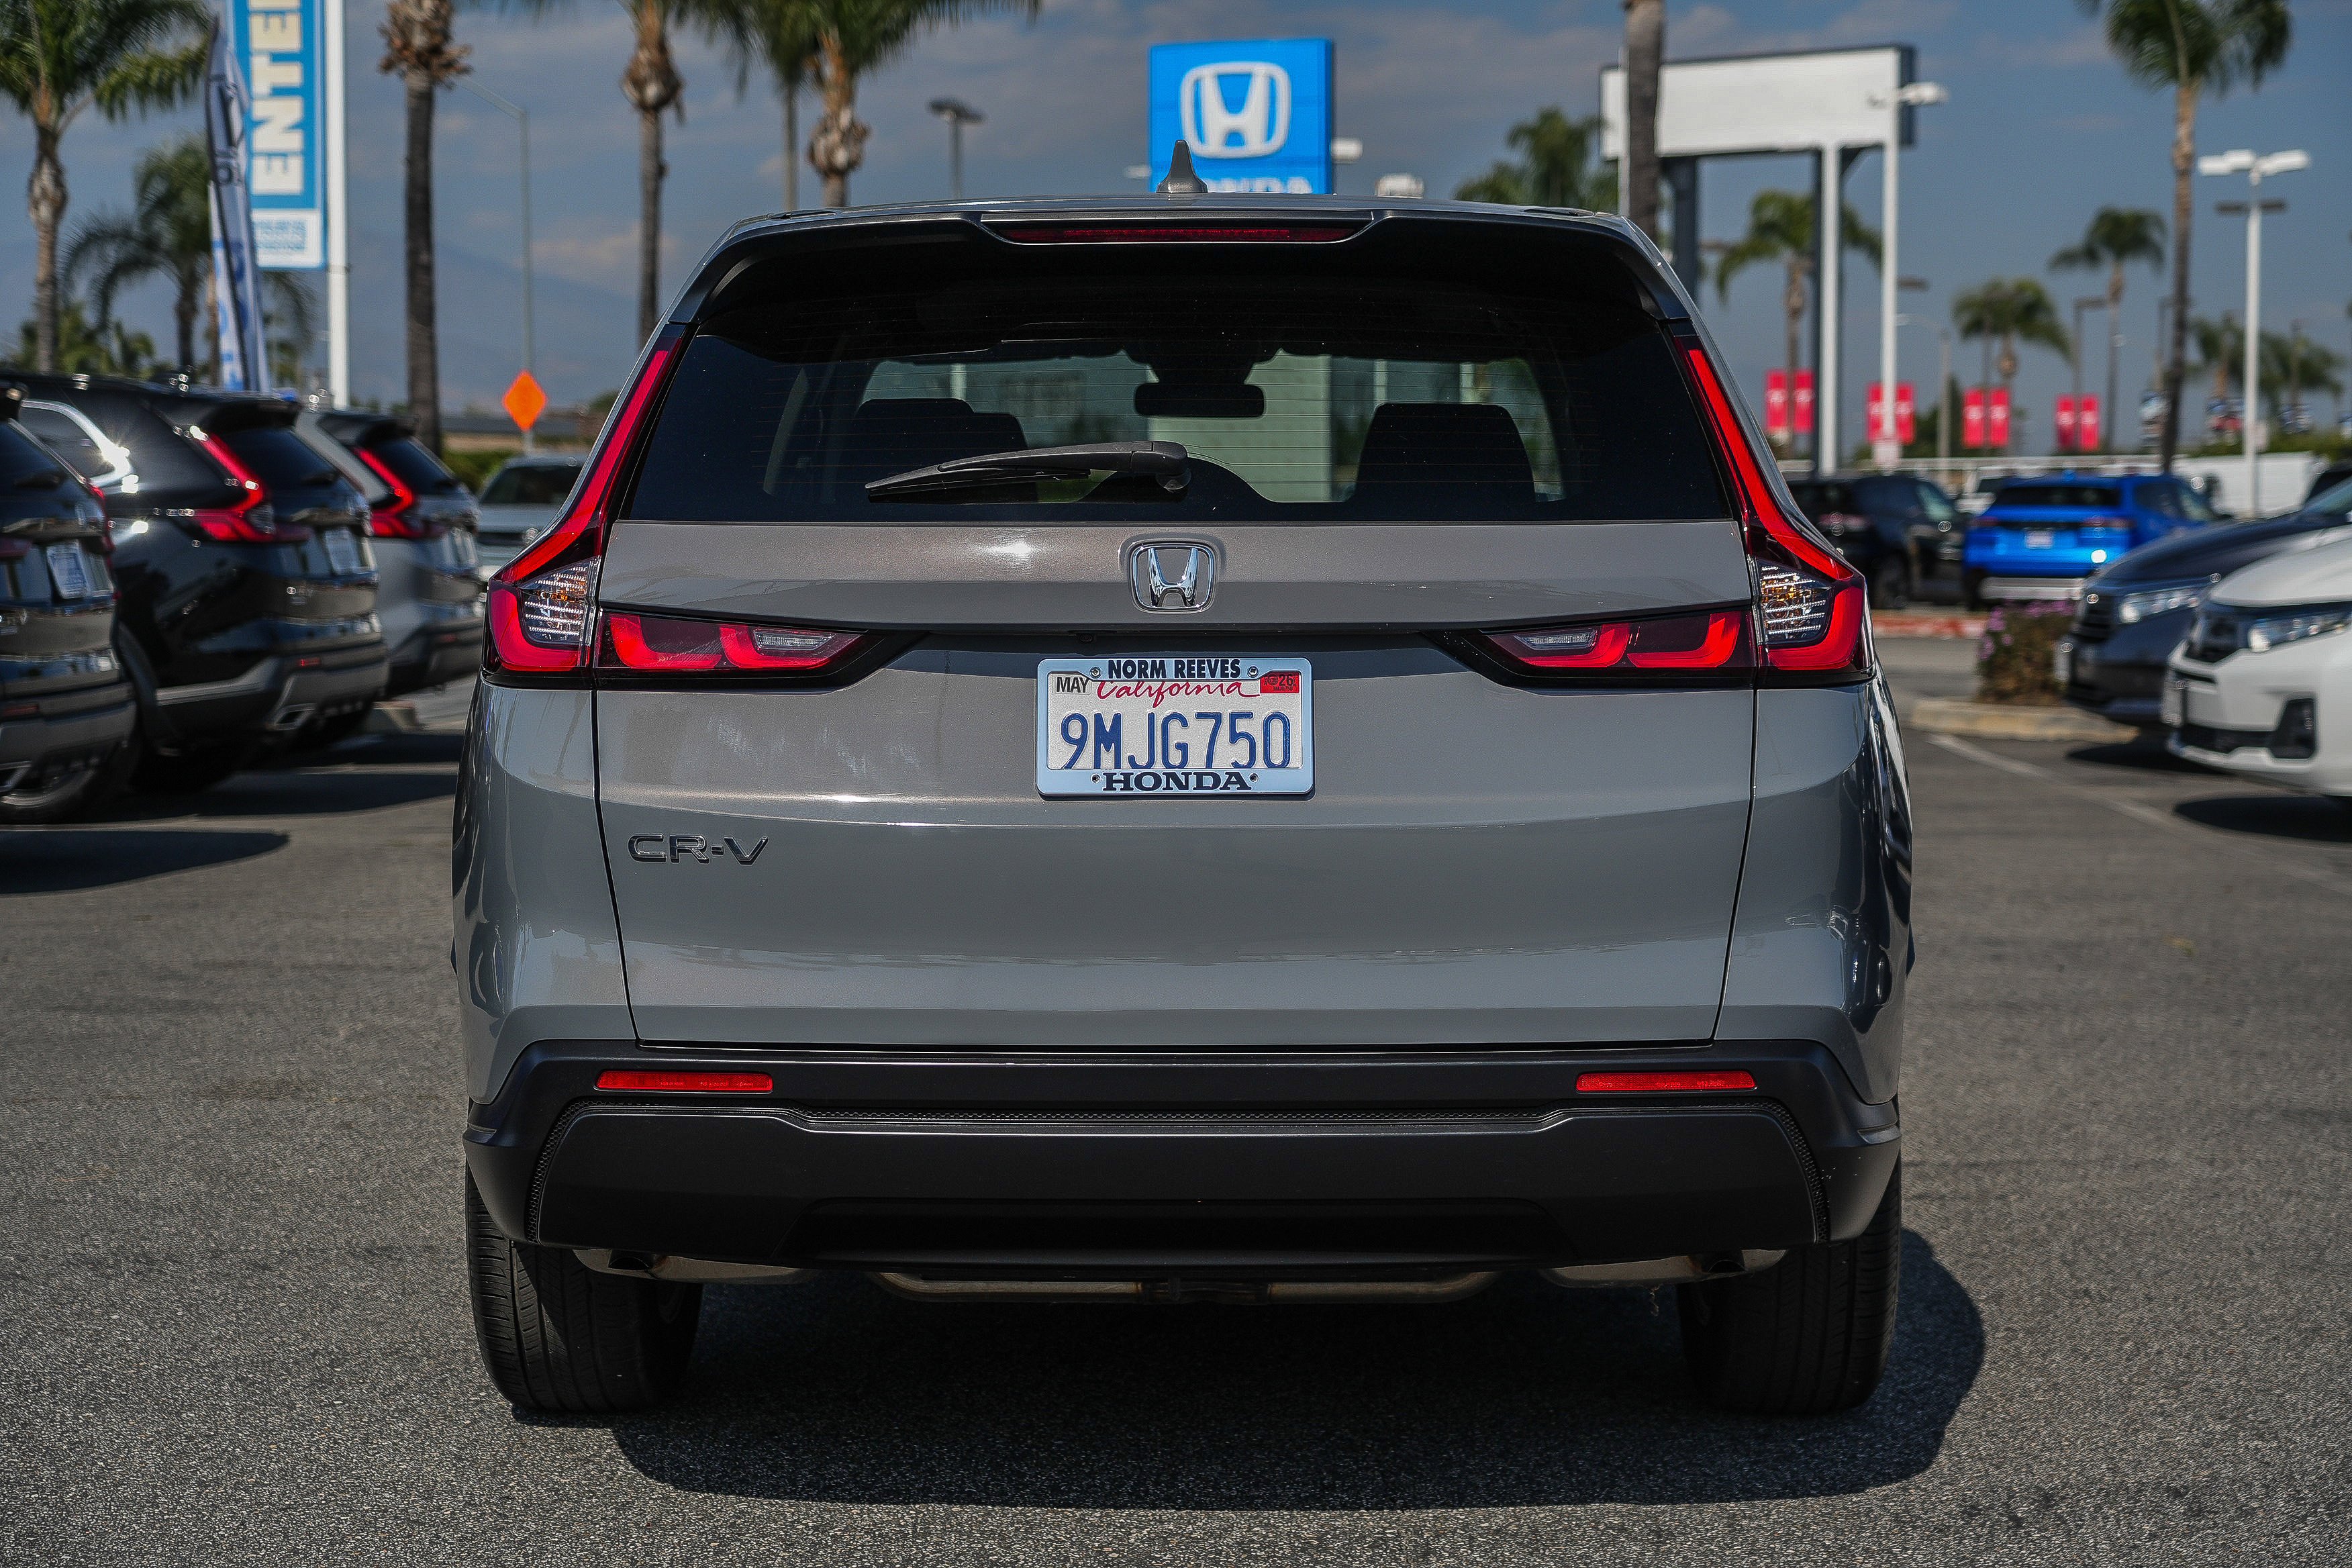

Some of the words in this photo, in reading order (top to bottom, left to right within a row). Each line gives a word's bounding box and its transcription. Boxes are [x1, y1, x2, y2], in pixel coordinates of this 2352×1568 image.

[249, 0, 304, 195] ENTE
[1108, 659, 1167, 679] NORM
[1174, 659, 1241, 679] REEVES
[1279, 674, 1293, 686] 26
[1056, 677, 1089, 693] MAY
[1097, 681, 1261, 709] California
[1061, 712, 1291, 769] 9MJG750
[1102, 771, 1253, 791] HONDA
[628, 834, 769, 865] CR-V
